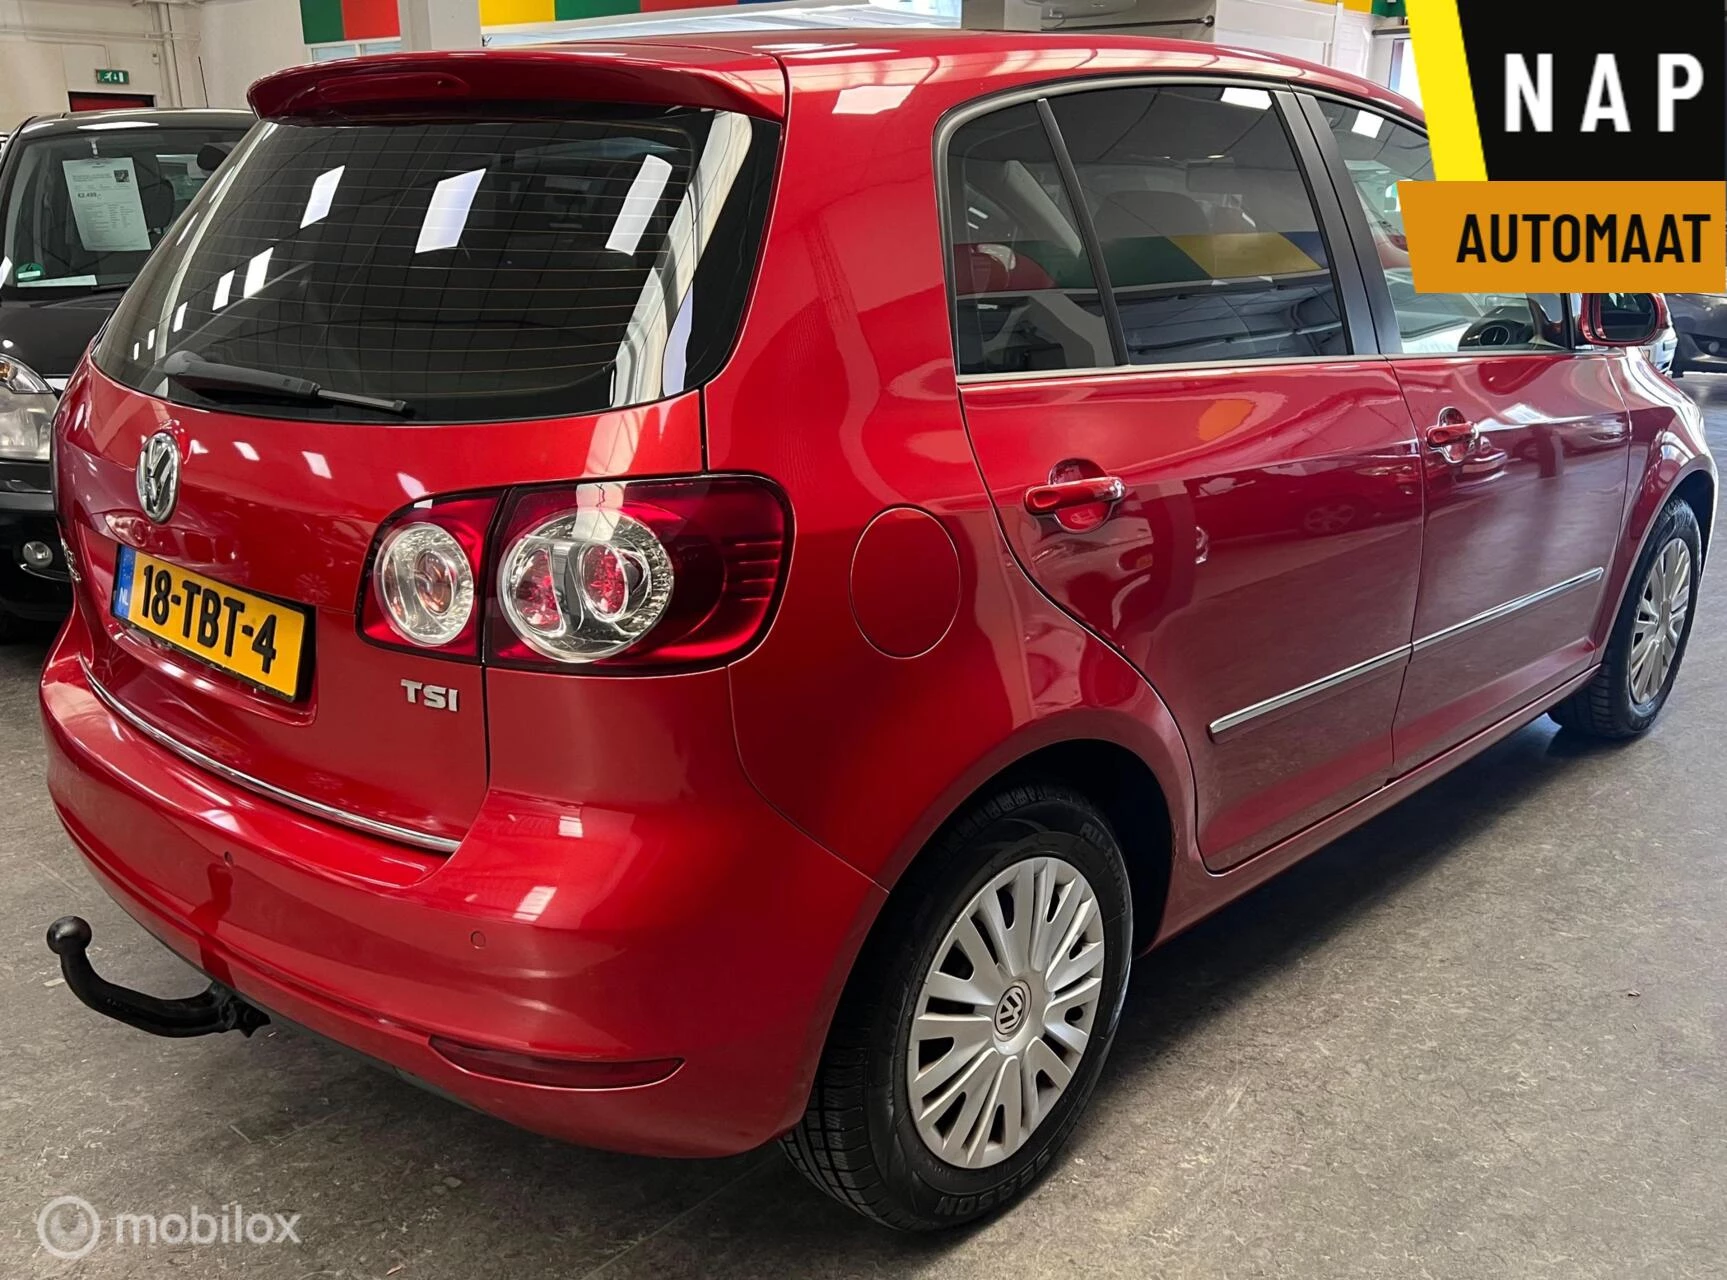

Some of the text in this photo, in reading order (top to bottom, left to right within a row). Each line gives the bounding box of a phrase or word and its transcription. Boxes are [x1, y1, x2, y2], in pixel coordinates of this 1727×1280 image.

[118, 587, 129, 606] NL
[142, 564, 277, 674] 18-TBT-4
[400, 678, 458, 712] TSI
